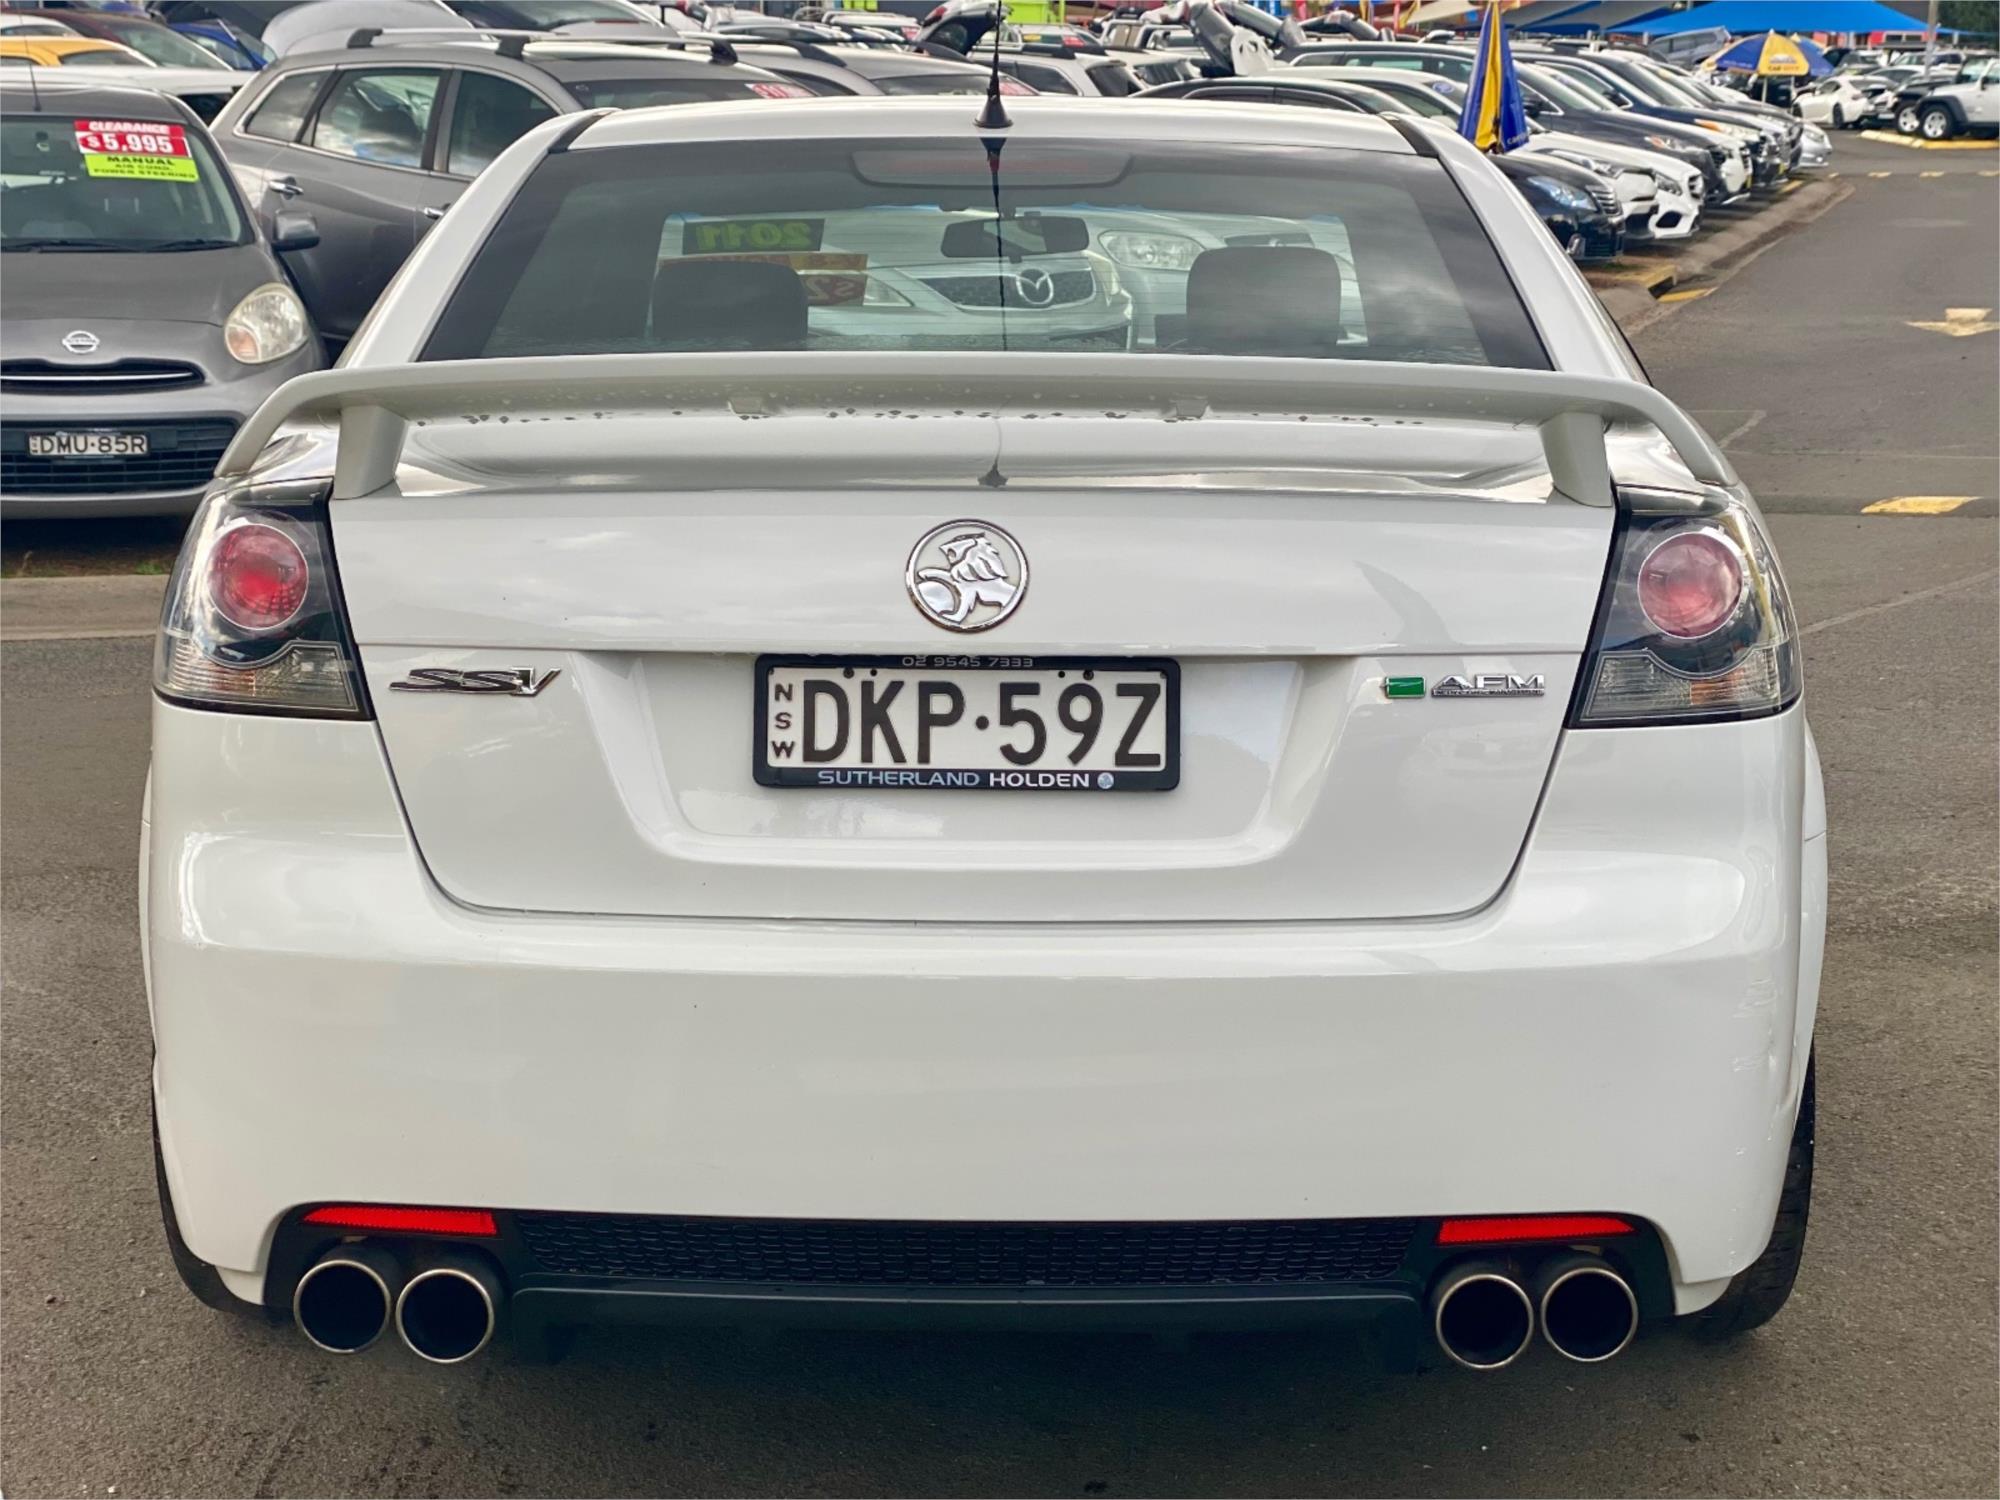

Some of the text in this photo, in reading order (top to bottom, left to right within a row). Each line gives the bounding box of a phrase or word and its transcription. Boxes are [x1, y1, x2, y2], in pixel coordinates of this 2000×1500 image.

[88, 121, 170, 135] CLEARANCE
[107, 156, 175, 166] MANUAL
[902, 656, 1034, 668] 02 9545 7333
[1432, 675, 1545, 690] AFM
[818, 770, 1090, 788] SUTHERLAND HOLDEN
